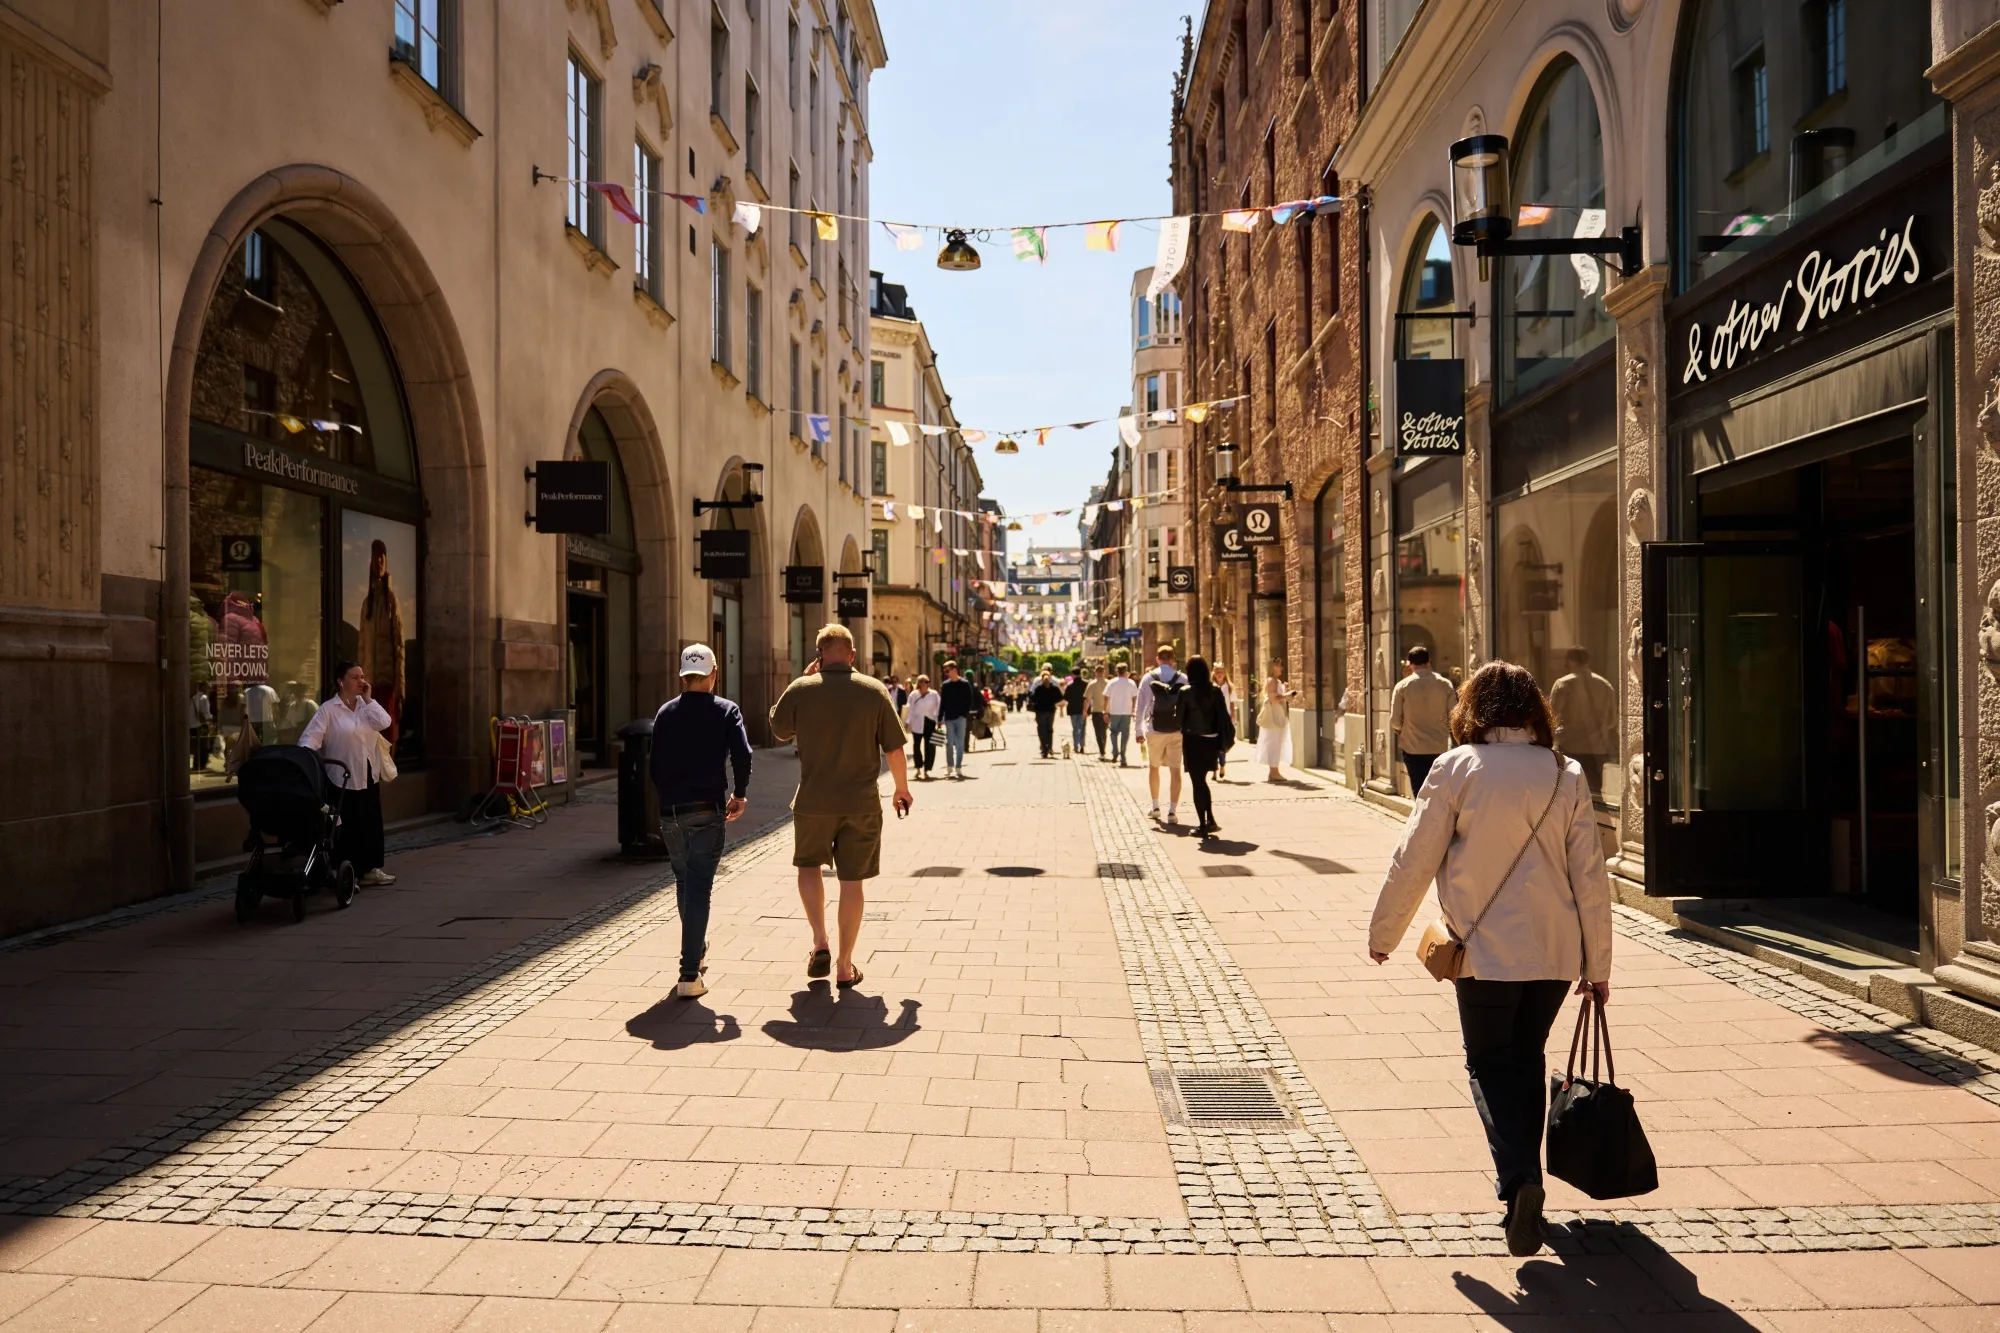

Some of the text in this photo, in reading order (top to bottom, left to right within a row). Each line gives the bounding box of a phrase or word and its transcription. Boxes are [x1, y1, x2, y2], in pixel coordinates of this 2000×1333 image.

[1683, 214, 1920, 384] & other Stories
[1400, 411, 1463, 434] & other
[1402, 429, 1460, 451] Stories
[244, 442, 358, 496] PeakPerformance
[540, 492, 603, 501] PeakPerformance
[205, 642, 269, 659] NEVER LETS
[208, 661, 231, 677] YOU
